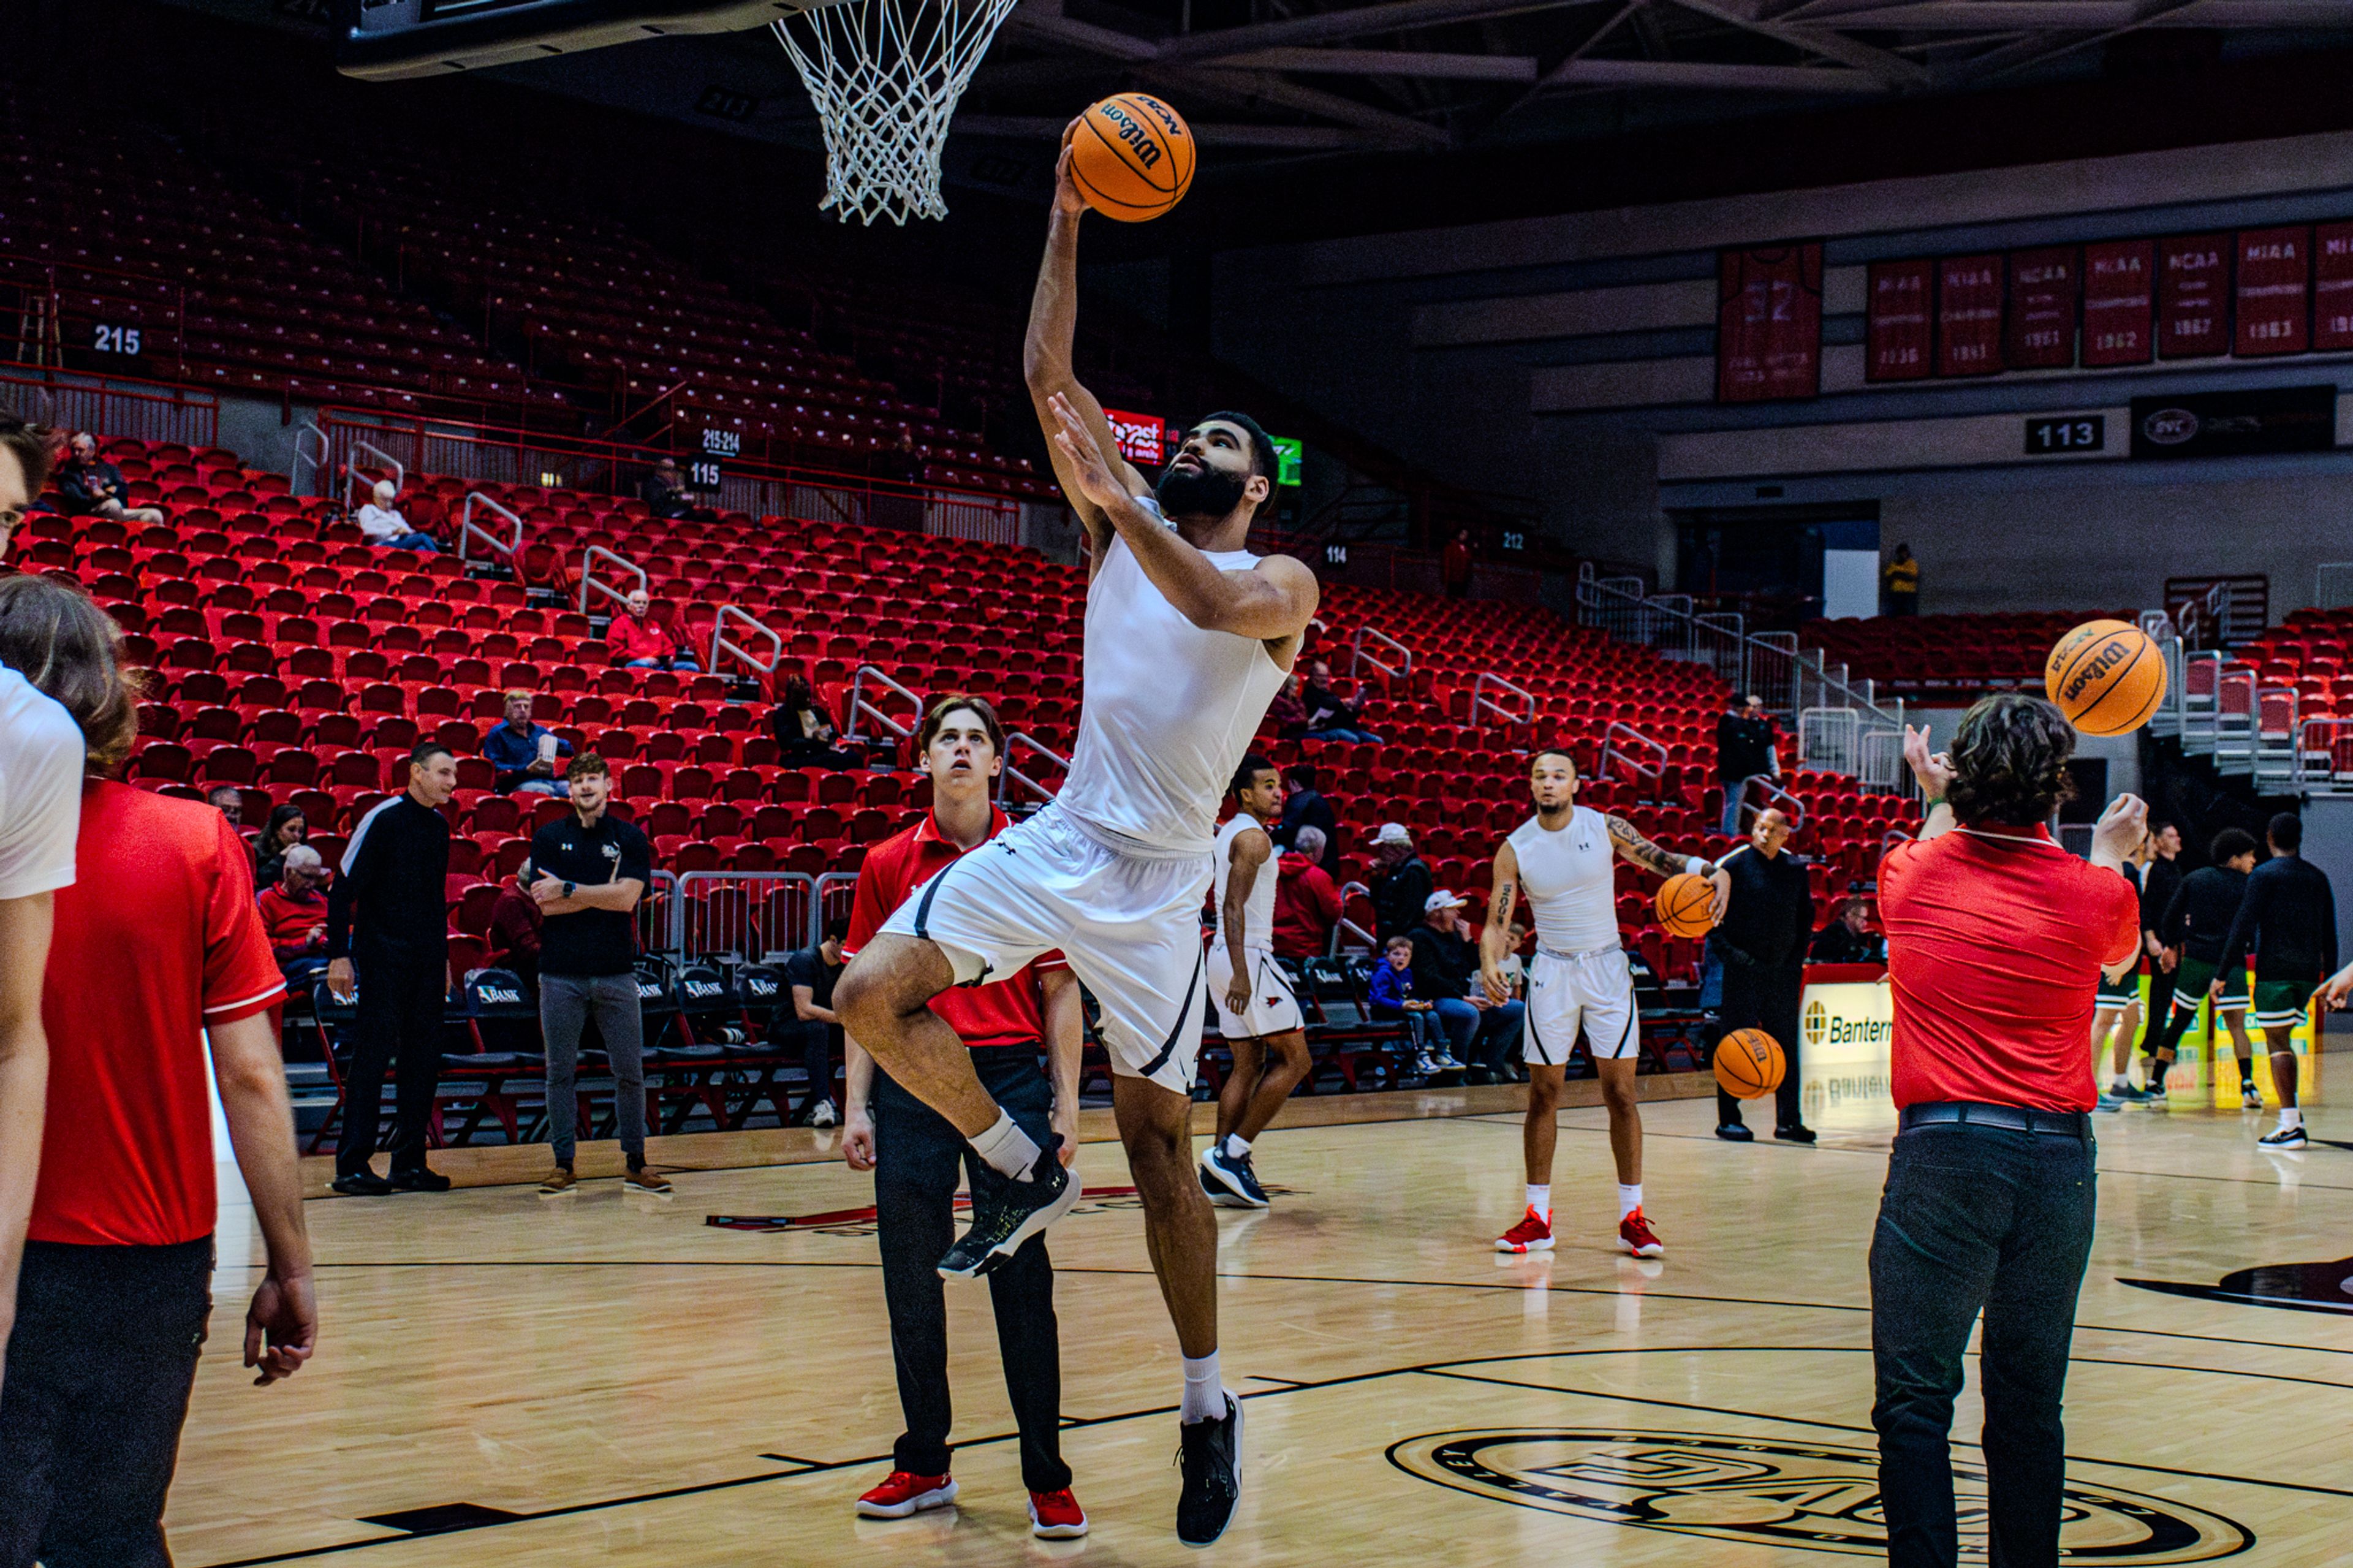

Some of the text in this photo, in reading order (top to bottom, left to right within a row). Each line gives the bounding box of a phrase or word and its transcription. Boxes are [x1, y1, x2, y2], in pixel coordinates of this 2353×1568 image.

[1101, 103, 1161, 170] Wilson
[94, 325, 141, 355] 215
[702, 428, 740, 453] 215-214
[2037, 422, 2094, 447] 113
[691, 461, 719, 485] 115
[1502, 531, 1524, 551] 212
[1326, 544, 1347, 564] 114
[2064, 642, 2130, 702] Wilson
[489, 988, 521, 1003] BANK
[696, 980, 723, 996] BANK
[1441, 1449, 1623, 1509] VALLEY
